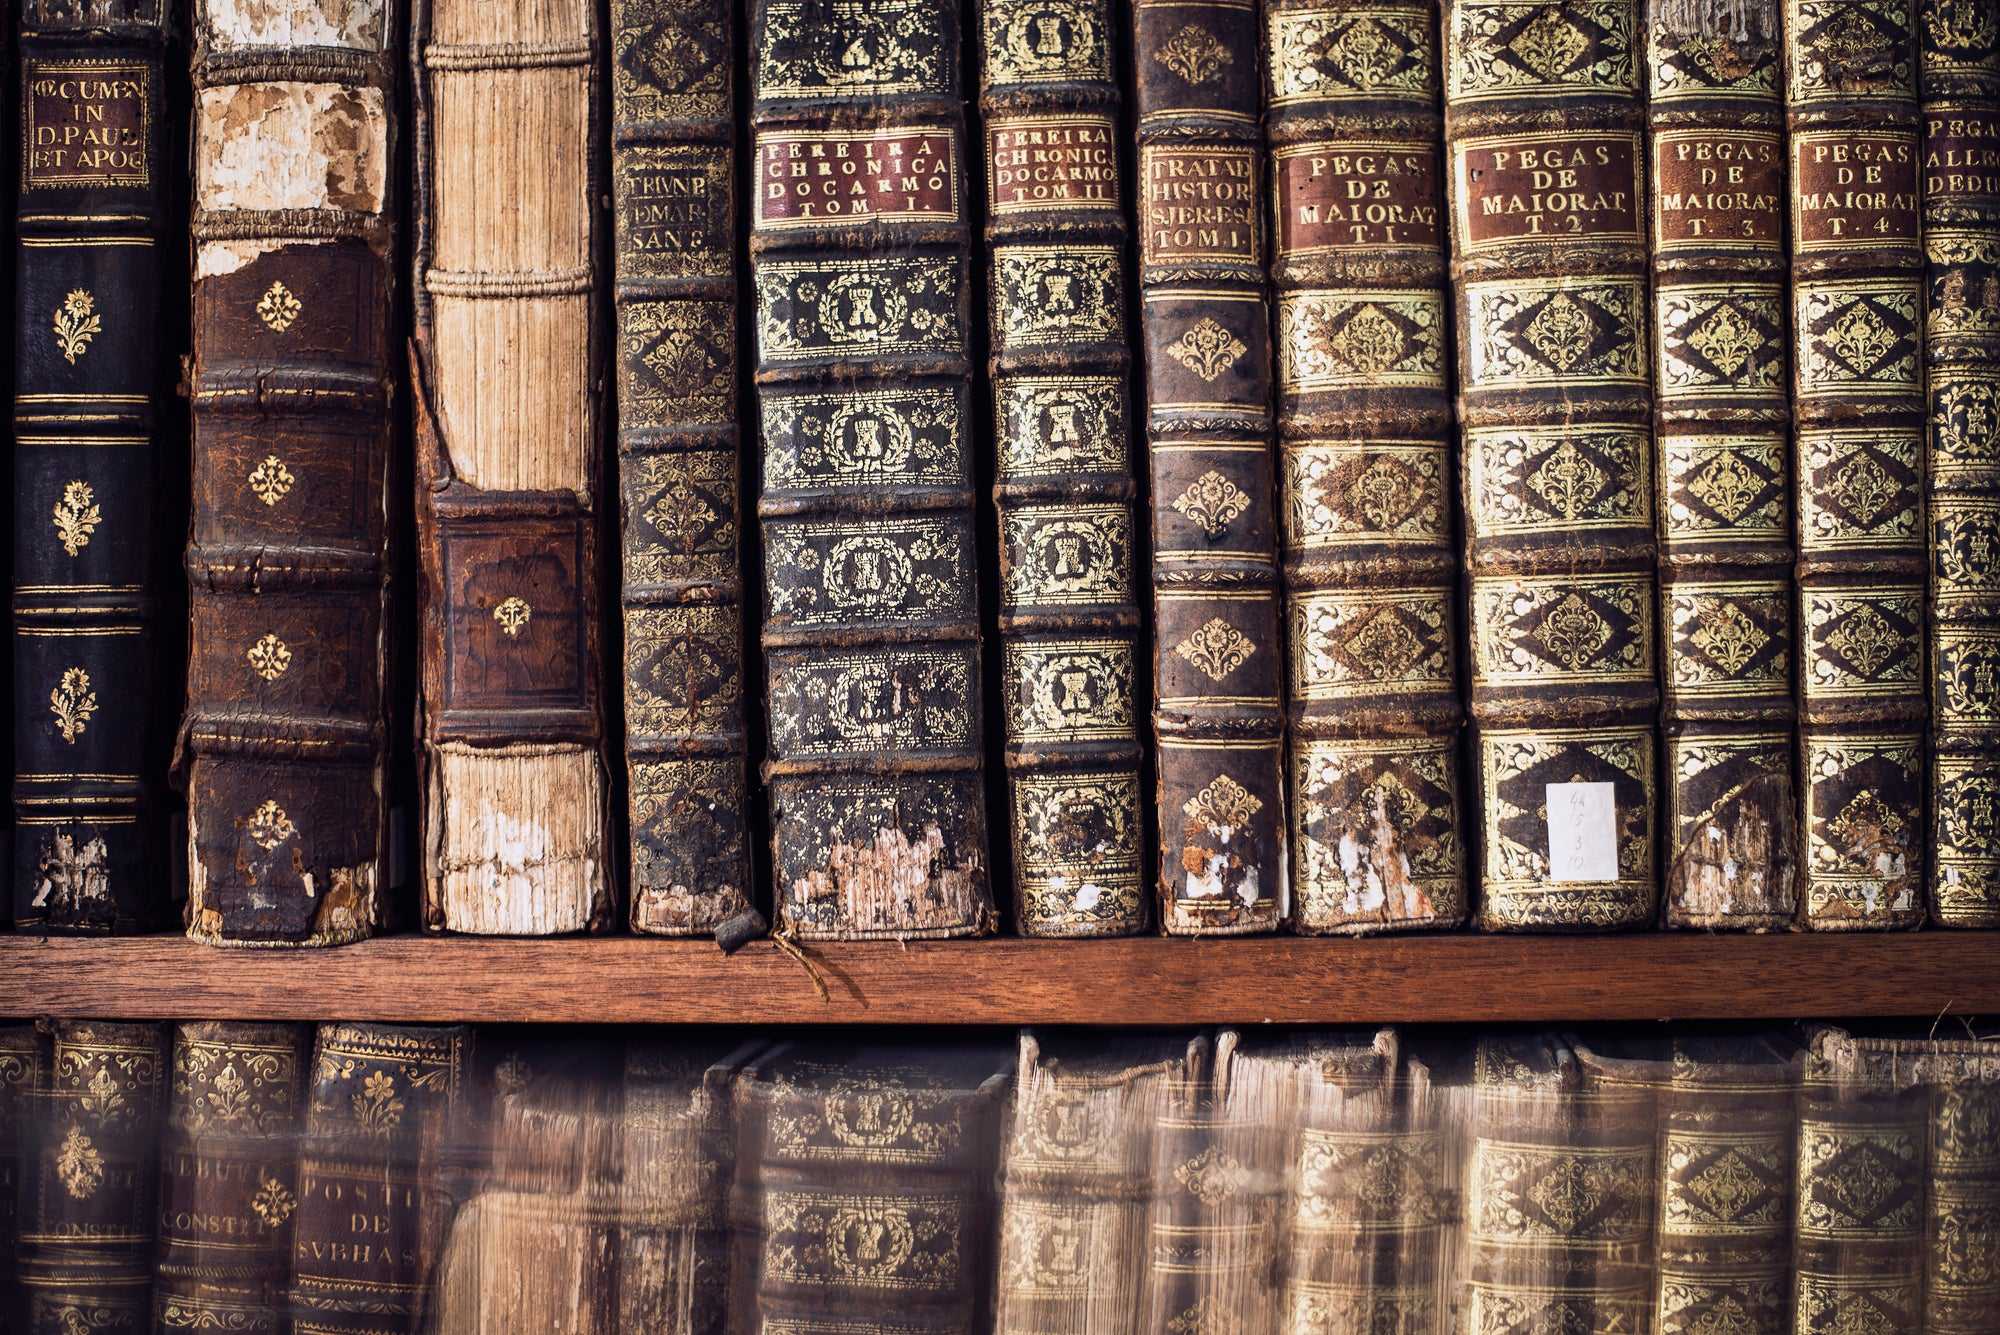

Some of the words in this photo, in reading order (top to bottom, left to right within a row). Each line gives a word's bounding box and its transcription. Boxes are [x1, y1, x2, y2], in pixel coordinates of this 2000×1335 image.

[74, 104, 104, 122] IN
[996, 129, 1108, 148] PEREIRA
[35, 150, 67, 168] ET
[767, 139, 933, 160] PEREIRA
[1676, 143, 1770, 164] PEGAS
[1814, 144, 1910, 164] PEGAS
[768, 158, 948, 178] CHRONICA
[1700, 166, 1745, 185] DE
[1837, 165, 1882, 186] DE
[1346, 180, 1391, 199] DE
[1531, 169, 1578, 190] DE
